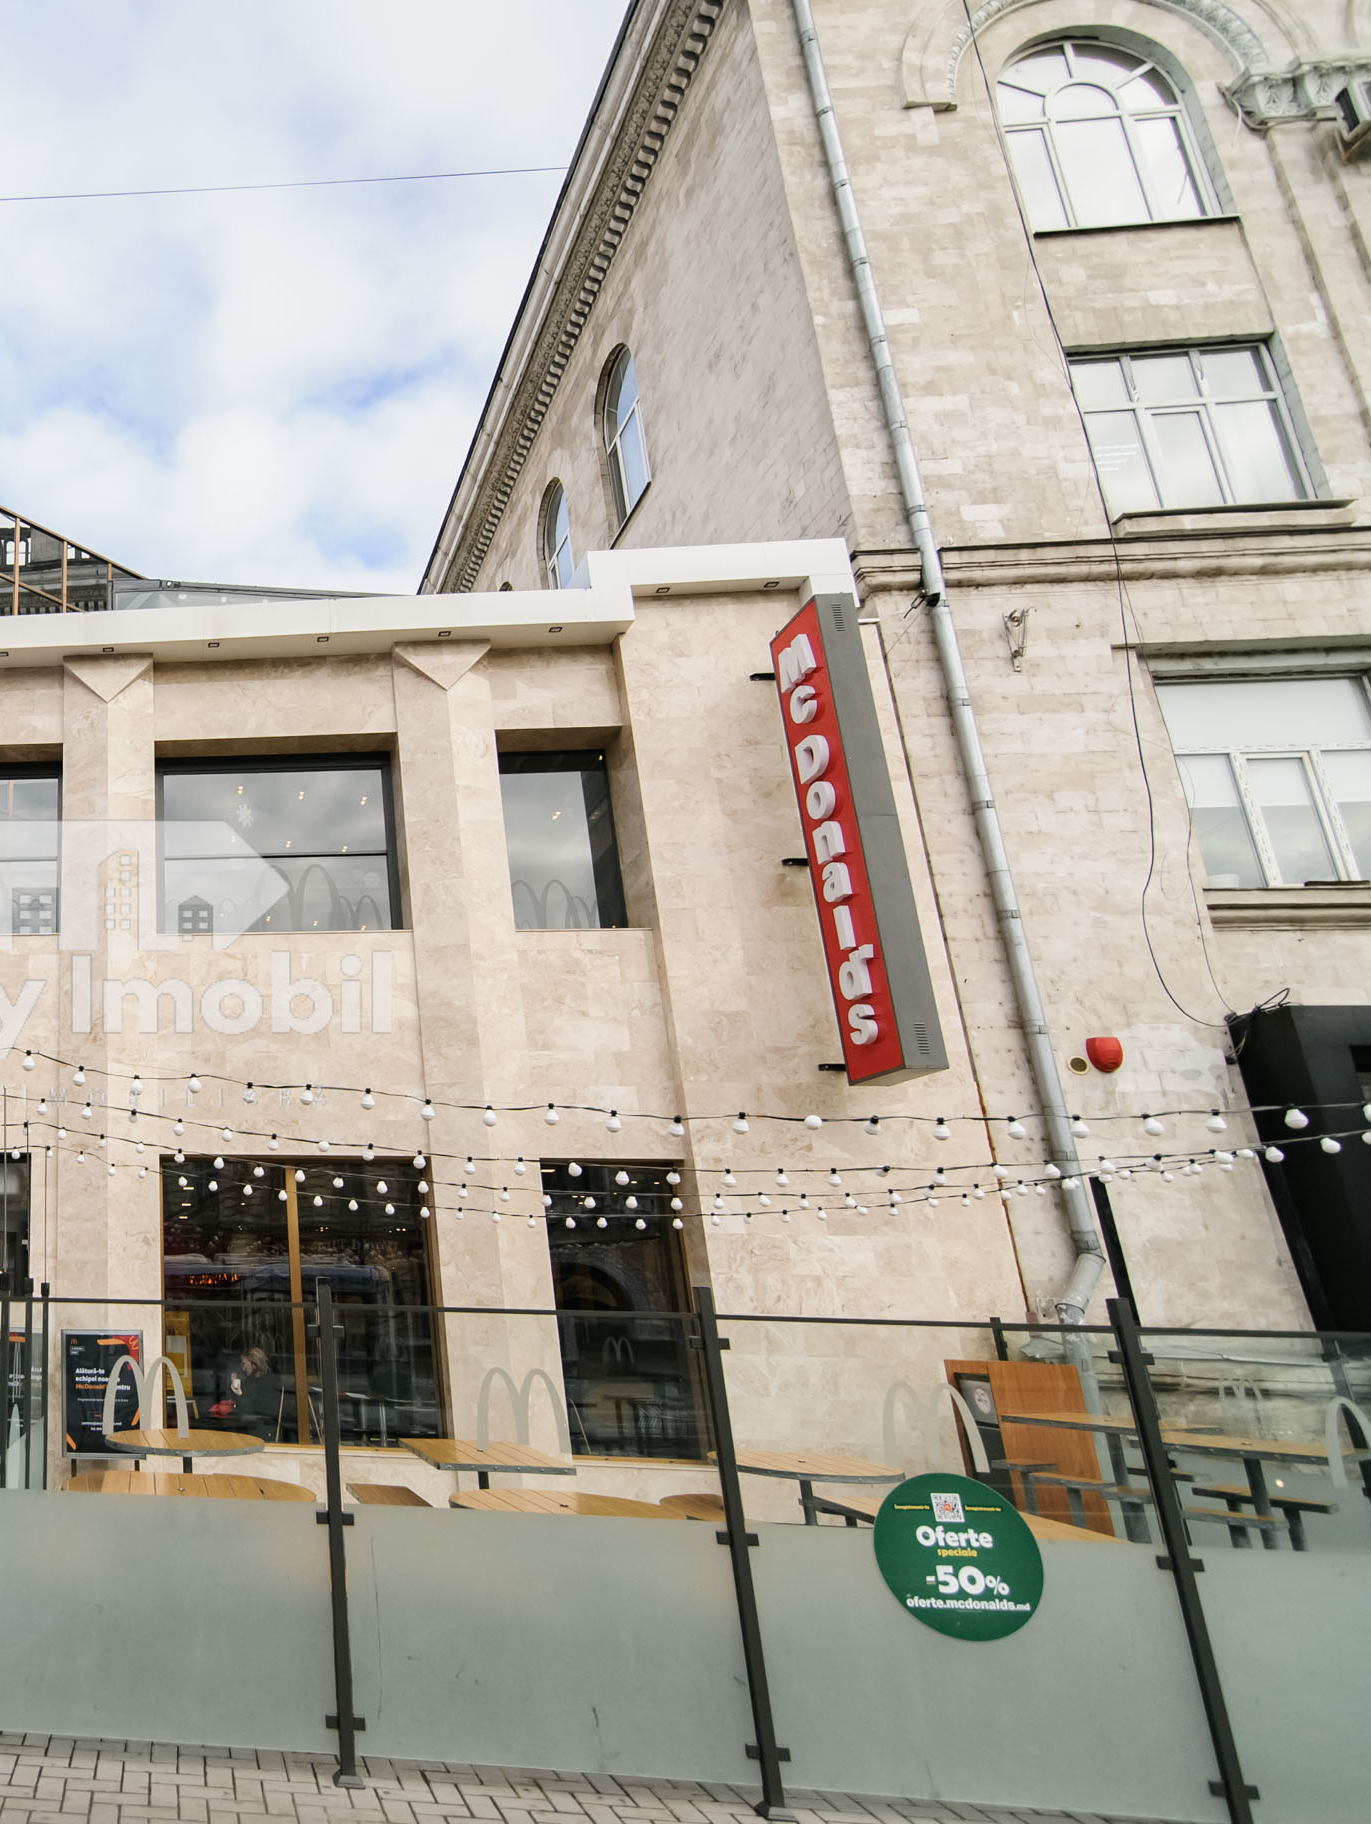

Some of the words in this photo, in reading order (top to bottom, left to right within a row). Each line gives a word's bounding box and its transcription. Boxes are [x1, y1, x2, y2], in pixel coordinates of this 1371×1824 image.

[916, 1525, 993, 1549] Oferte
[937, 1548, 978, 1558] speciale
[926, 1565, 1010, 1595] -50%
[906, 1596, 1031, 1612] oferte.mcdonalds.md
